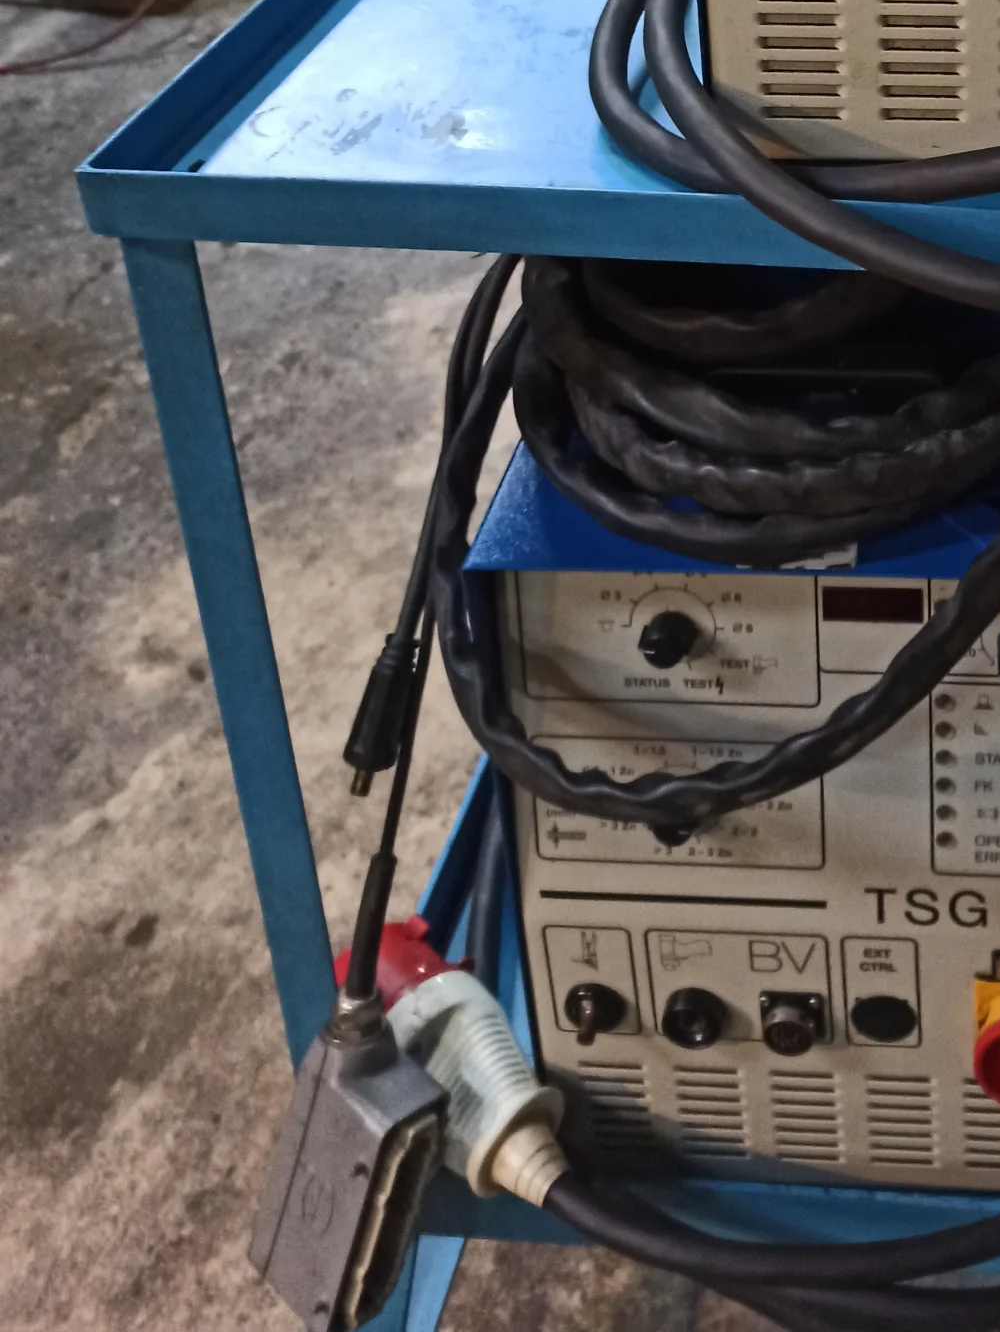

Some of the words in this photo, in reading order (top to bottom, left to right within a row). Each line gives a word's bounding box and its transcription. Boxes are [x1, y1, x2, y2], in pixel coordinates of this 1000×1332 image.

[624, 678, 671, 688] STATUS
[974, 781, 993, 792] FK
[863, 887, 988, 928] TSG
[748, 939, 815, 974] BV
[863, 948, 891, 959] EXT
[859, 961, 897, 973] CTRL
